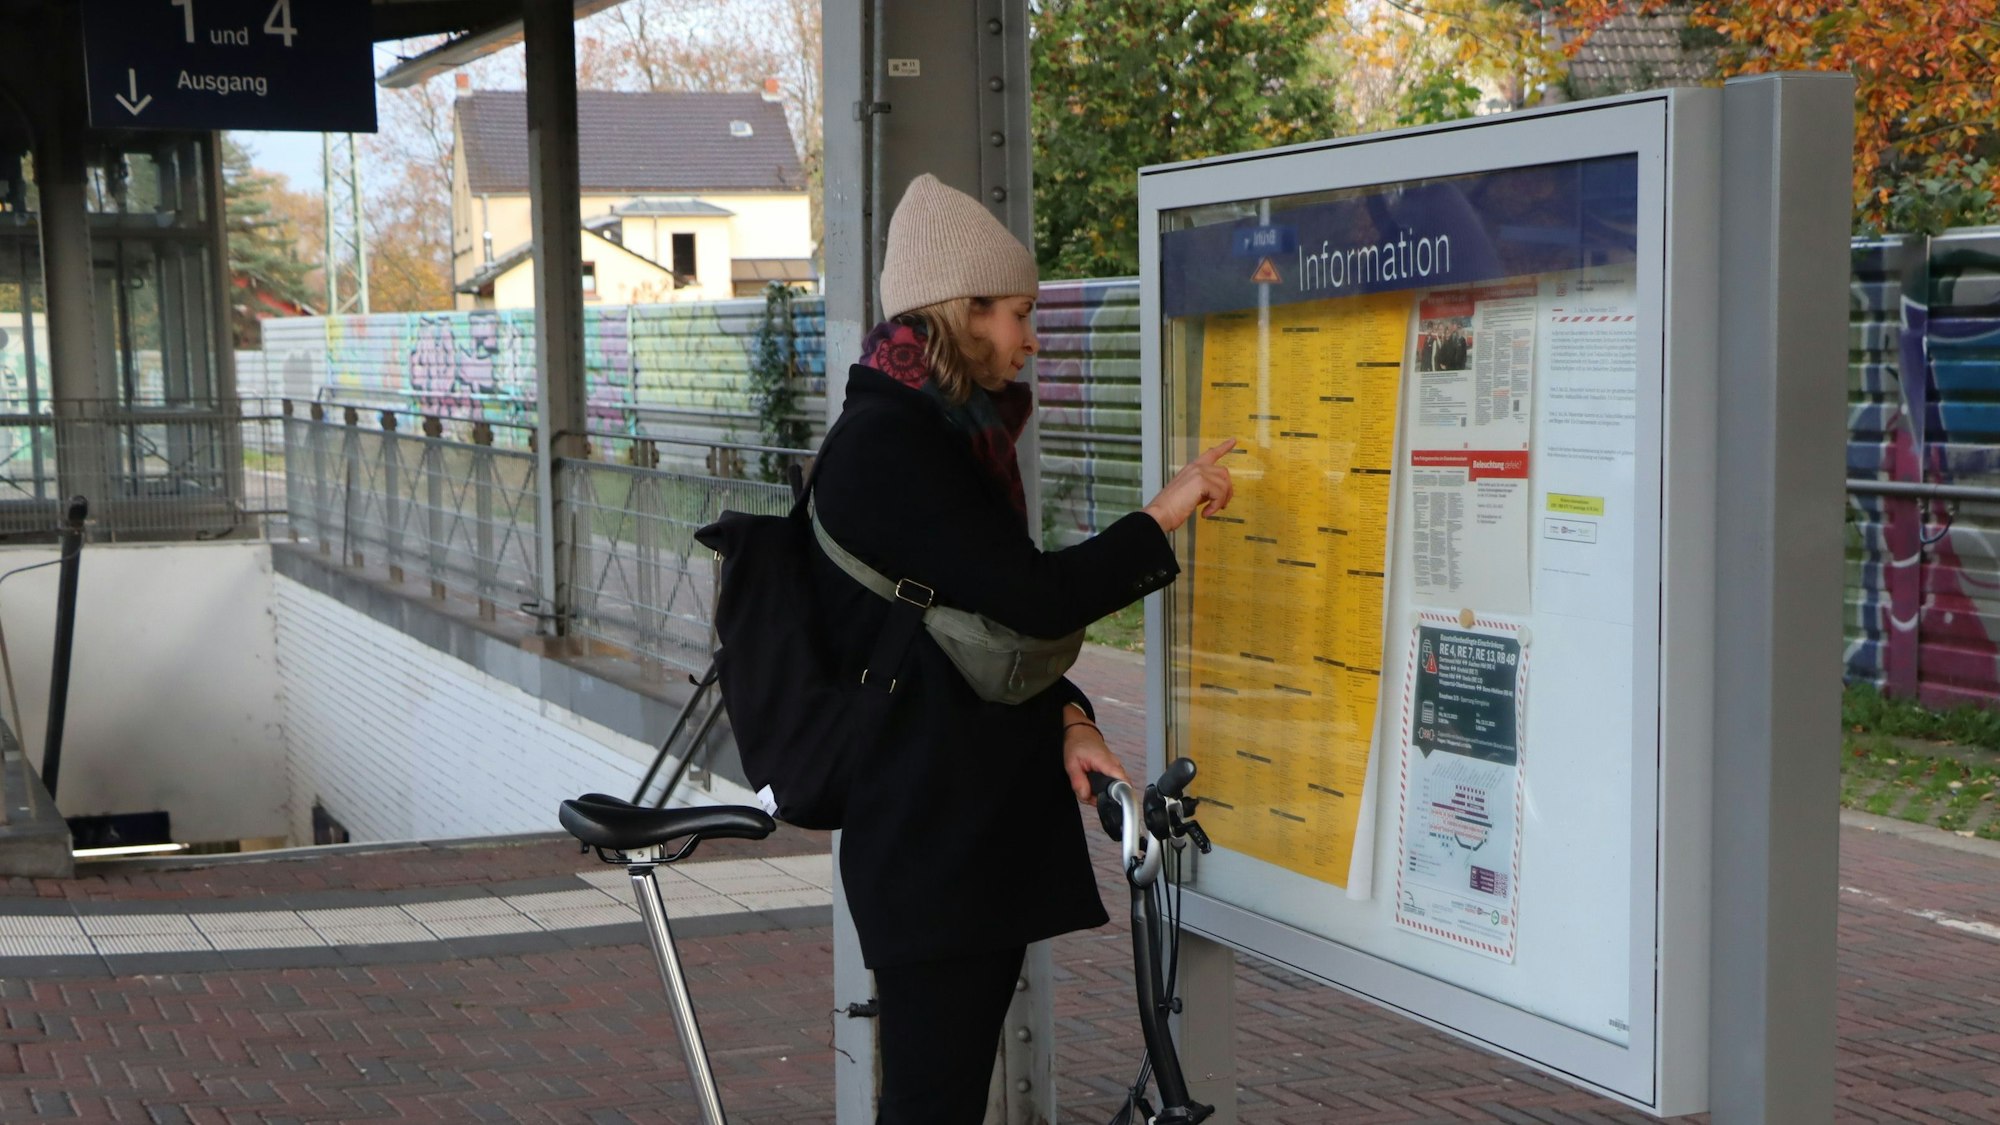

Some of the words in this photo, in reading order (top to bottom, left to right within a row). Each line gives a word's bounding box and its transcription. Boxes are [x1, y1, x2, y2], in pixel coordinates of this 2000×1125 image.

[171, 0, 195, 43] 1
[210, 26, 250, 46] und
[263, 0, 299, 47] 4
[177, 69, 268, 97] Ausgang
[1299, 229, 1450, 291] Information
[1472, 459, 1505, 471] Beleuchtung
[1440, 643, 1449, 656] RE
[1457, 646, 1467, 659] RE
[1475, 648, 1485, 661] RE
[1496, 651, 1506, 664] RB
[1506, 653, 1516, 666] 48
